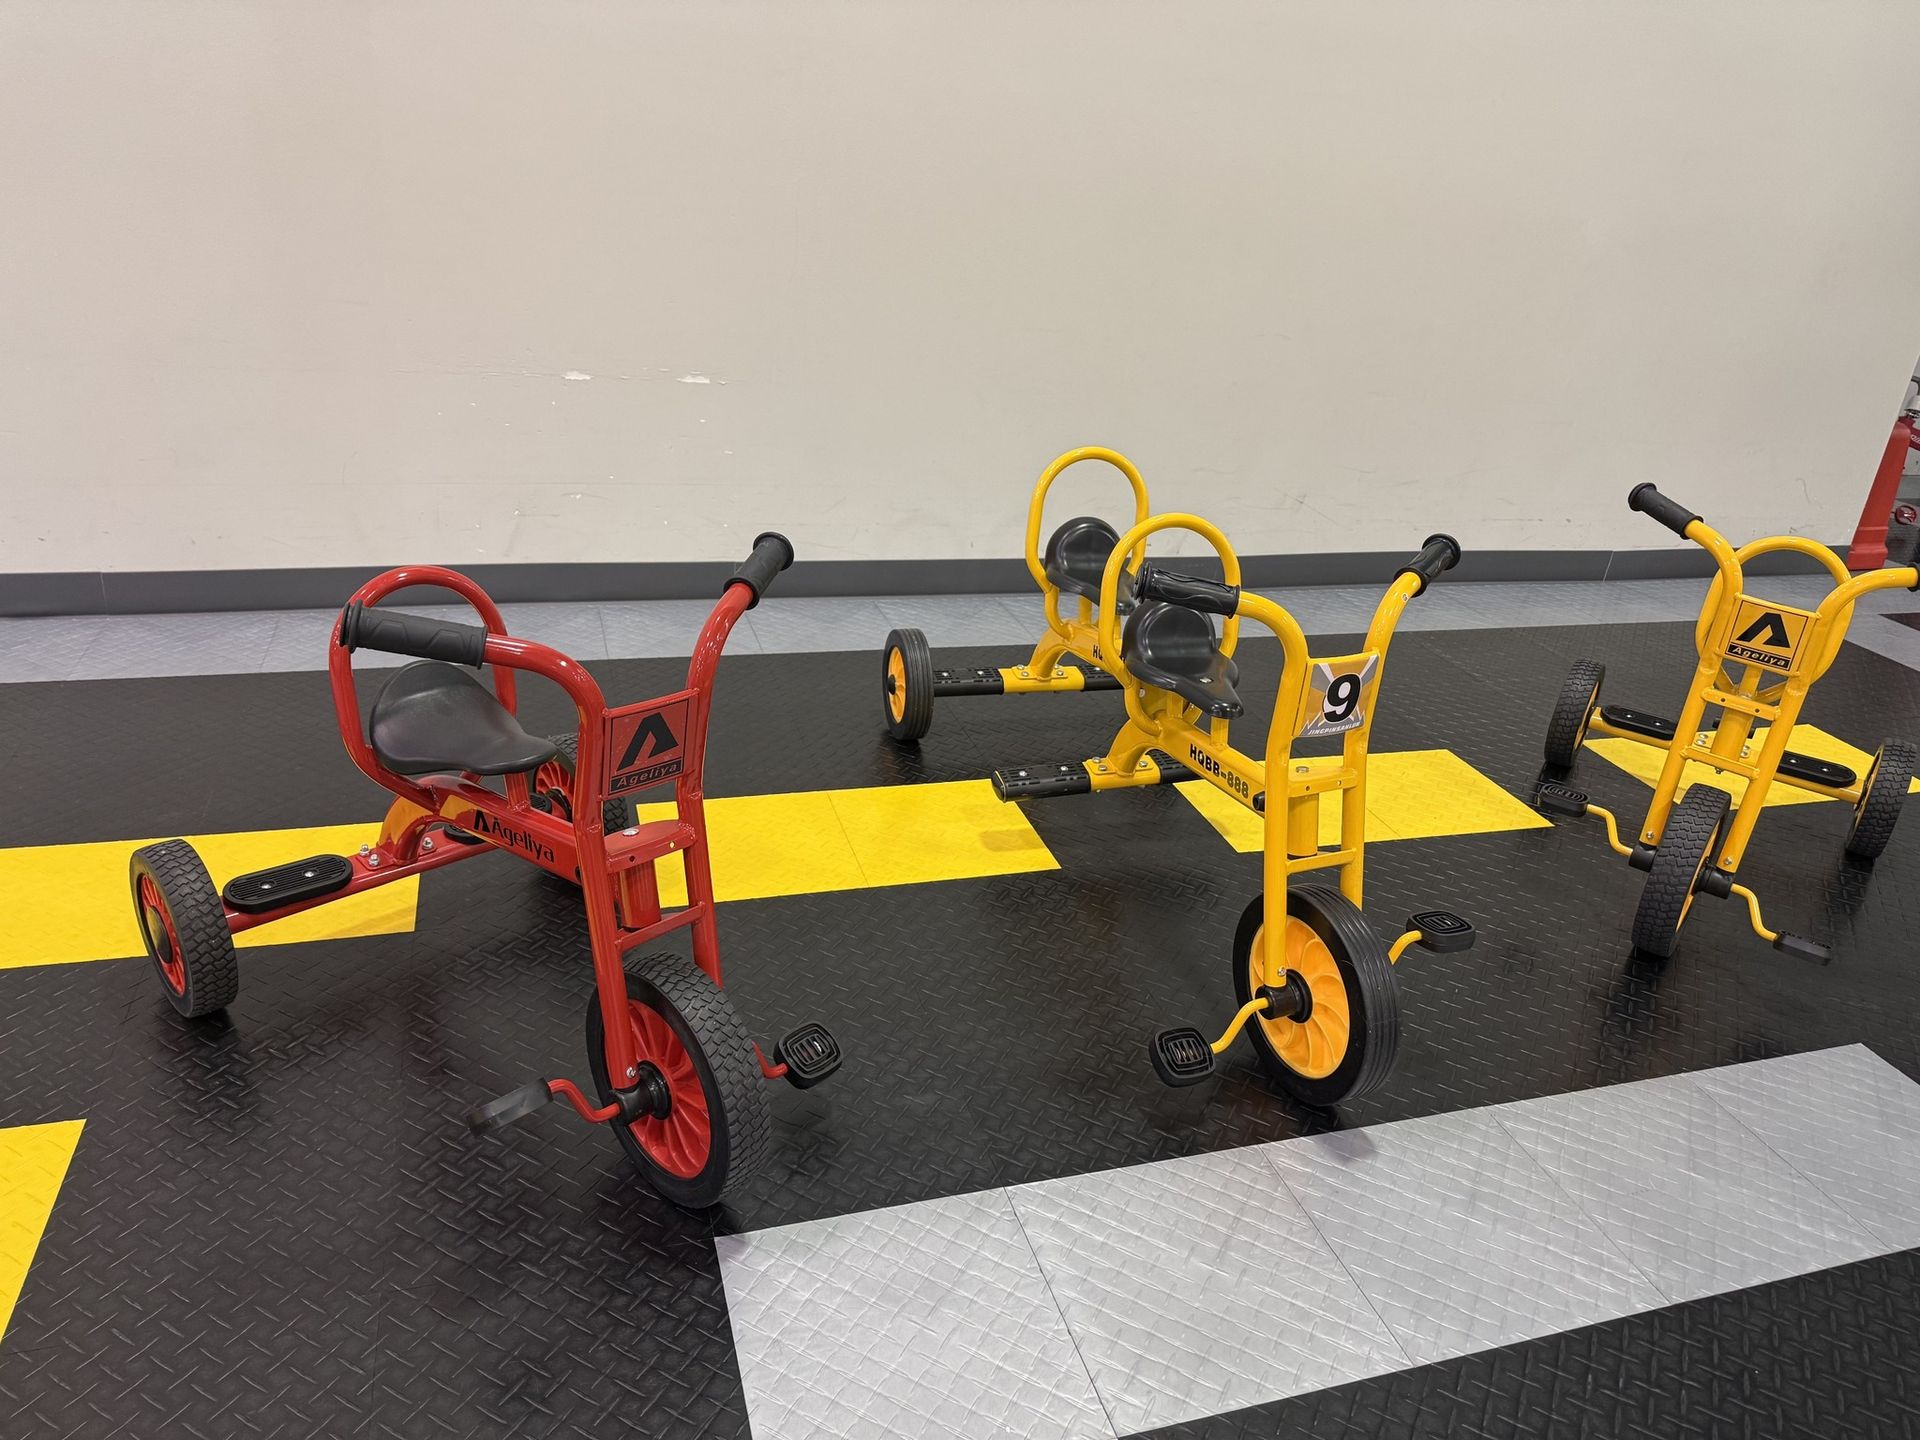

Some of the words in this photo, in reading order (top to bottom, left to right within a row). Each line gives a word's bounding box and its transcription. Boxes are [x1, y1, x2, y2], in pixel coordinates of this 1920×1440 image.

[1732, 646, 1787, 666] Ageliya
[1323, 673, 1361, 723] 9
[616, 763, 678, 788] Ageliya
[1190, 743, 1249, 799] HQBB-888
[492, 816, 555, 864] Ageliya
